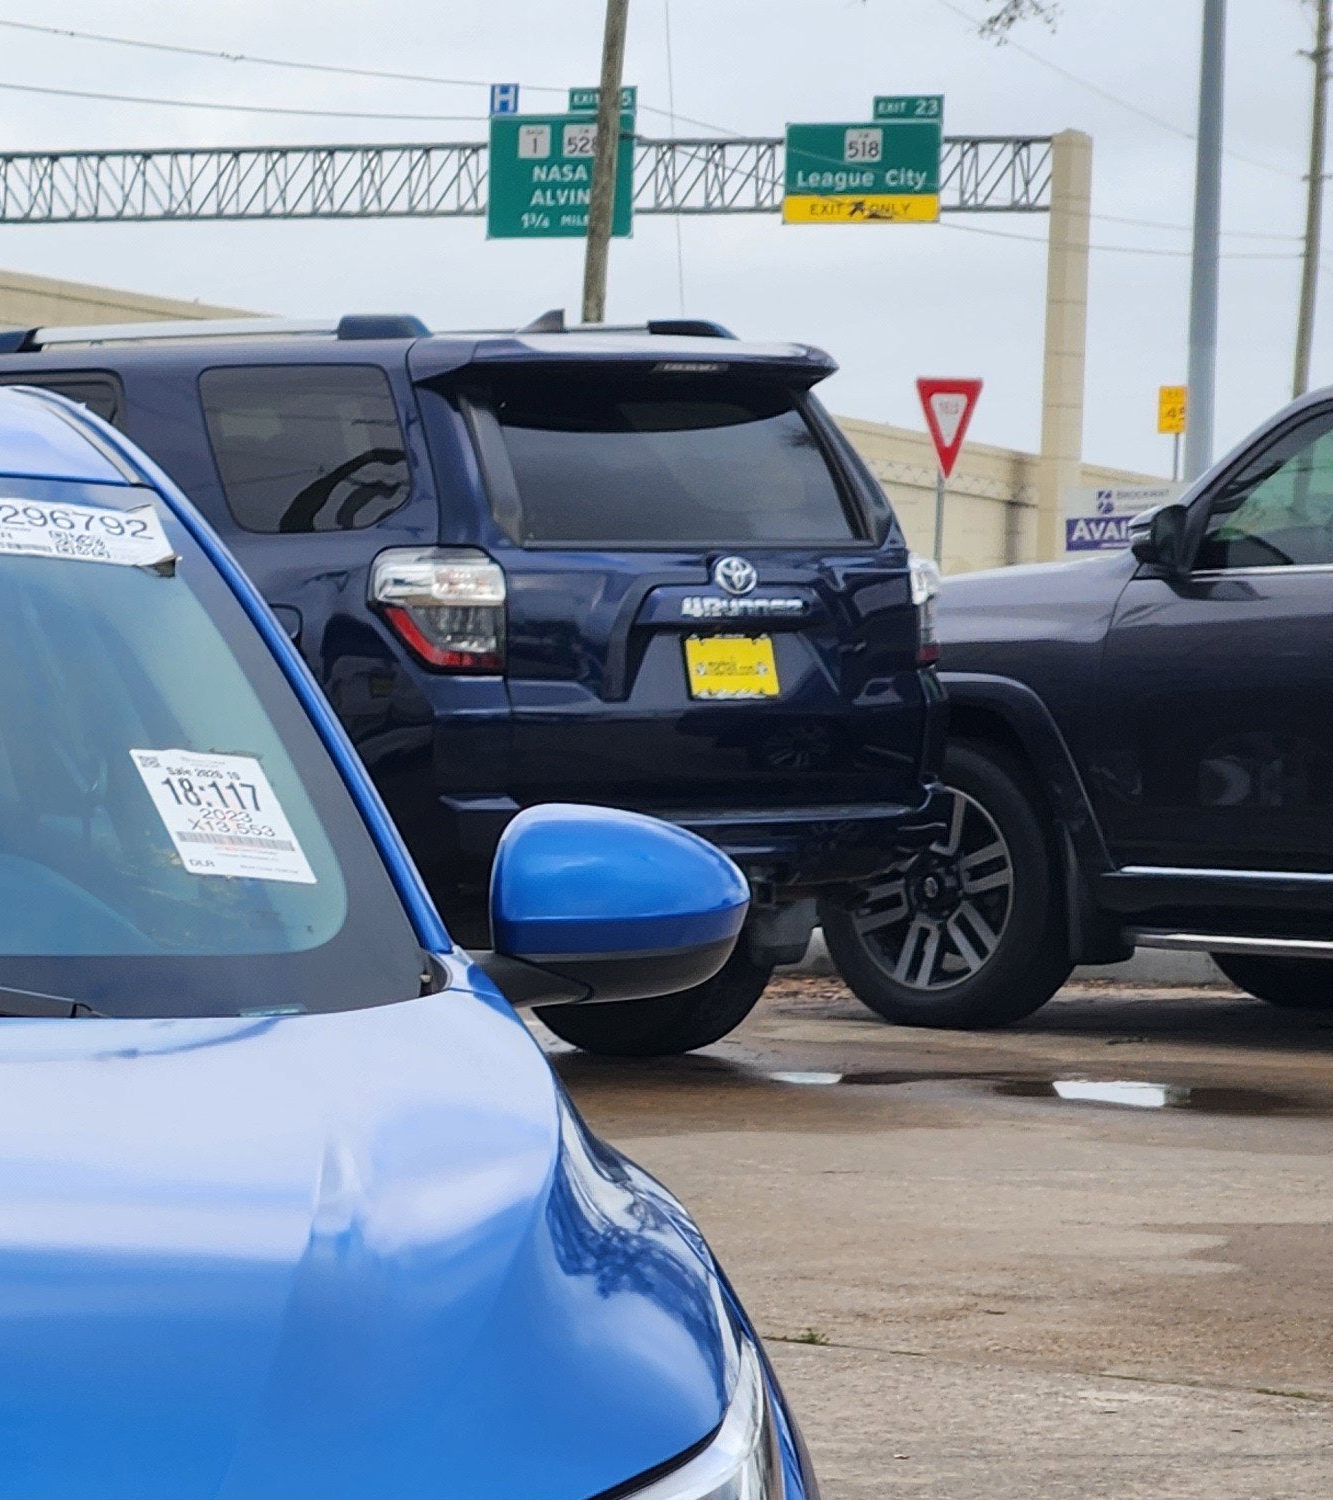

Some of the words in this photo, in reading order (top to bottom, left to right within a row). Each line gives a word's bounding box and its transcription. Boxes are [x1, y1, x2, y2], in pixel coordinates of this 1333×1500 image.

[877, 102, 907, 114] EXIT
[914, 100, 938, 115] 23
[848, 140, 879, 158] 518
[532, 164, 588, 182] NASA
[796, 170, 875, 191] League
[885, 167, 927, 190] City
[810, 203, 842, 216] EXIT
[869, 203, 911, 216] ONLY
[1071, 519, 1130, 542] AVAI
[161, 777, 261, 812] 18:117
[199, 807, 253, 823] 2023
